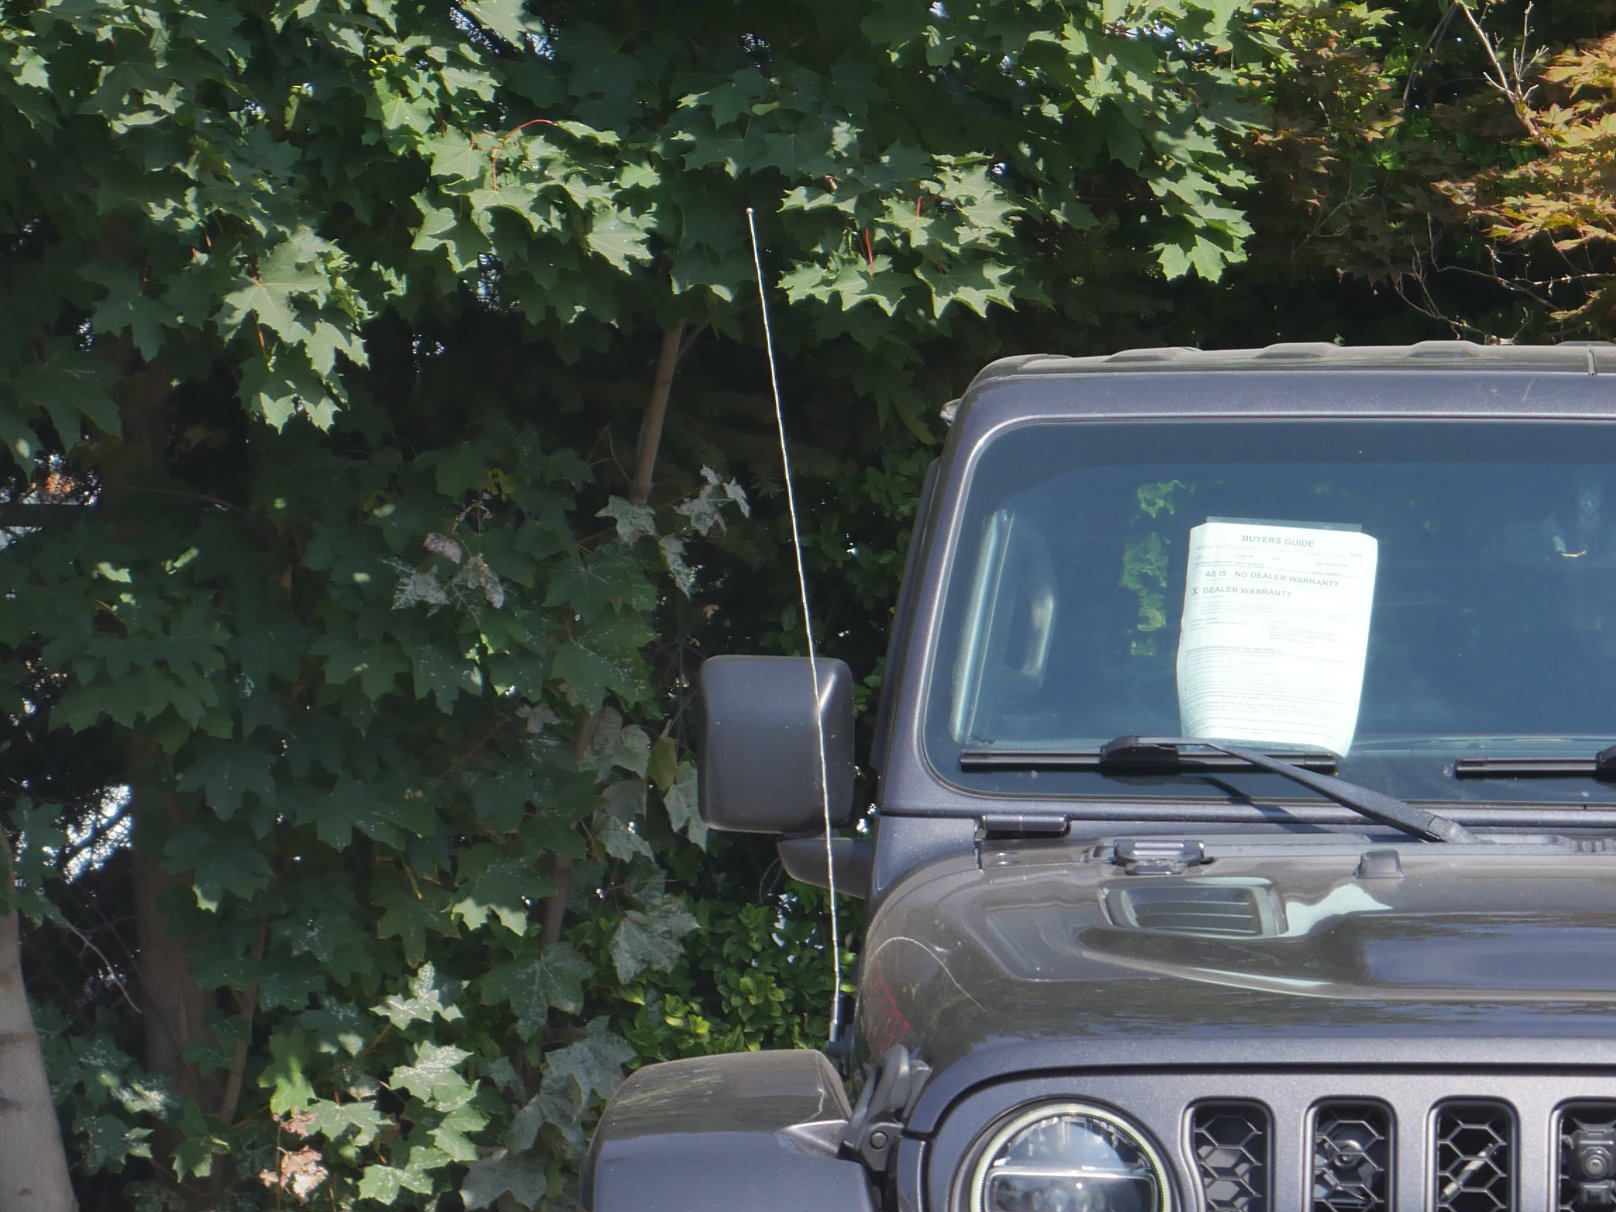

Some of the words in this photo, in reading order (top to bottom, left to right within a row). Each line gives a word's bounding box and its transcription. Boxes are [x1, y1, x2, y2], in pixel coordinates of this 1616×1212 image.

[1242, 534, 1281, 545] BUYERS
[1284, 538, 1315, 547] GUIDE
[1251, 572, 1286, 582] DEALER
[1288, 576, 1339, 587] WARRANTY
[1241, 587, 1292, 597] WARRANTY
